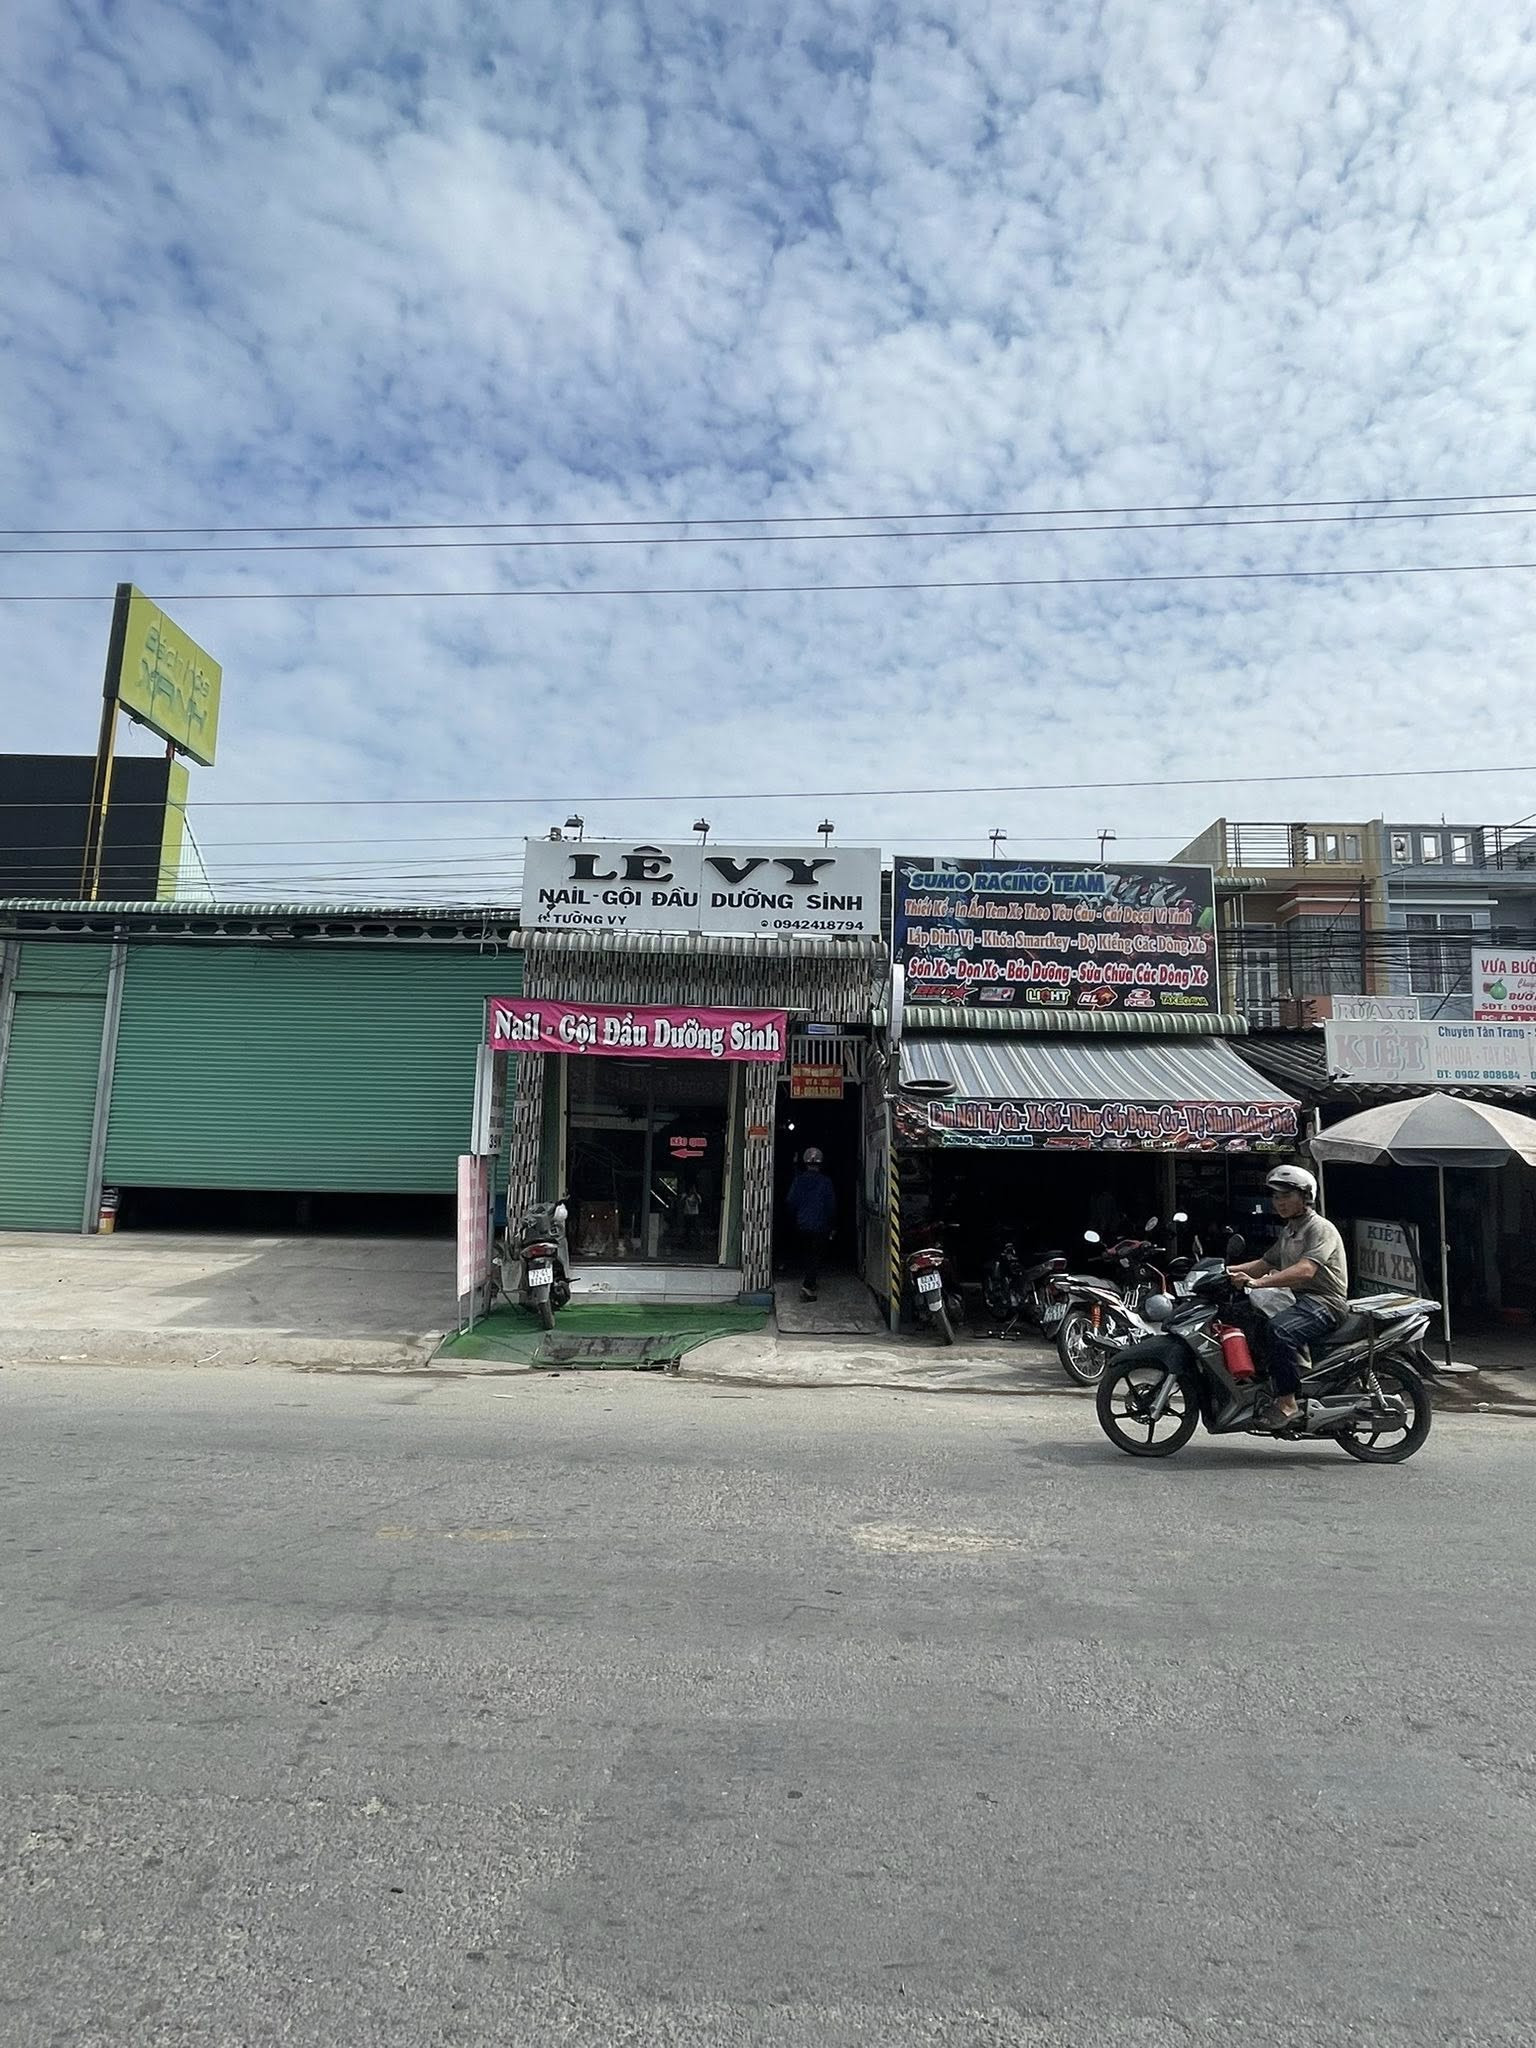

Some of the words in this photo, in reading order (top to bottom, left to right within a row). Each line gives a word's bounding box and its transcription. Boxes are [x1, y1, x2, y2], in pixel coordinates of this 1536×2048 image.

[568, 845, 674, 882] LÊ
[705, 857, 836, 885] VY
[909, 872, 972, 891] SUMO
[973, 872, 1050, 894] RACING
[1051, 872, 1106, 895] TEAM
[651, 886, 699, 908] ĐẦU
[711, 887, 793, 909] DƯỠNG
[553, 910, 603, 925] TƯỜNG
[607, 915, 628, 925] VY
[773, 919, 864, 931] 0942418794
[955, 901, 968, 918] In
[985, 902, 1007, 919] Tem
[1007, 902, 1023, 920] Xe
[1024, 903, 1050, 920] Theo
[1052, 904, 1072, 921] Yêu
[930, 928, 959, 949] Định
[982, 930, 1015, 947] Khóa
[1015, 931, 1070, 953] Smartkey
[1078, 933, 1096, 953] Độ
[1133, 935, 1156, 952] Các
[1157, 935, 1188, 956] Dòng
[1188, 936, 1206, 954] Xe
[932, 958, 949, 978] Xe
[956, 960, 982, 984] Dọn
[982, 960, 1000, 980] Xe
[1006, 958, 1031, 980] Bảo
[1078, 961, 1103, 984] Sửa
[1104, 963, 1135, 984] Chữa
[1135, 963, 1156, 985] Các
[1158, 963, 1190, 988] Dòng
[1191, 965, 1209, 986] Xe
[494, 1009, 540, 1040] Nail
[559, 1013, 597, 1052] Gội
[602, 1012, 647, 1046] Đầu
[653, 1018, 725, 1057] Dưỡng
[730, 1021, 779, 1051] Sinh
[1438, 1026, 1474, 1039] Chuyên
[1498, 1026, 1525, 1039] Trang
[1335, 1024, 1427, 1080] KIỆT
[1455, 1070, 1480, 1079] 0902
[979, 1103, 1000, 1133] Tay
[1000, 1103, 1020, 1130] Ga
[1026, 1103, 1044, 1131] Xe
[1367, 1224, 1404, 1245] KIỆT
[1390, 1254, 1415, 1283] XE
